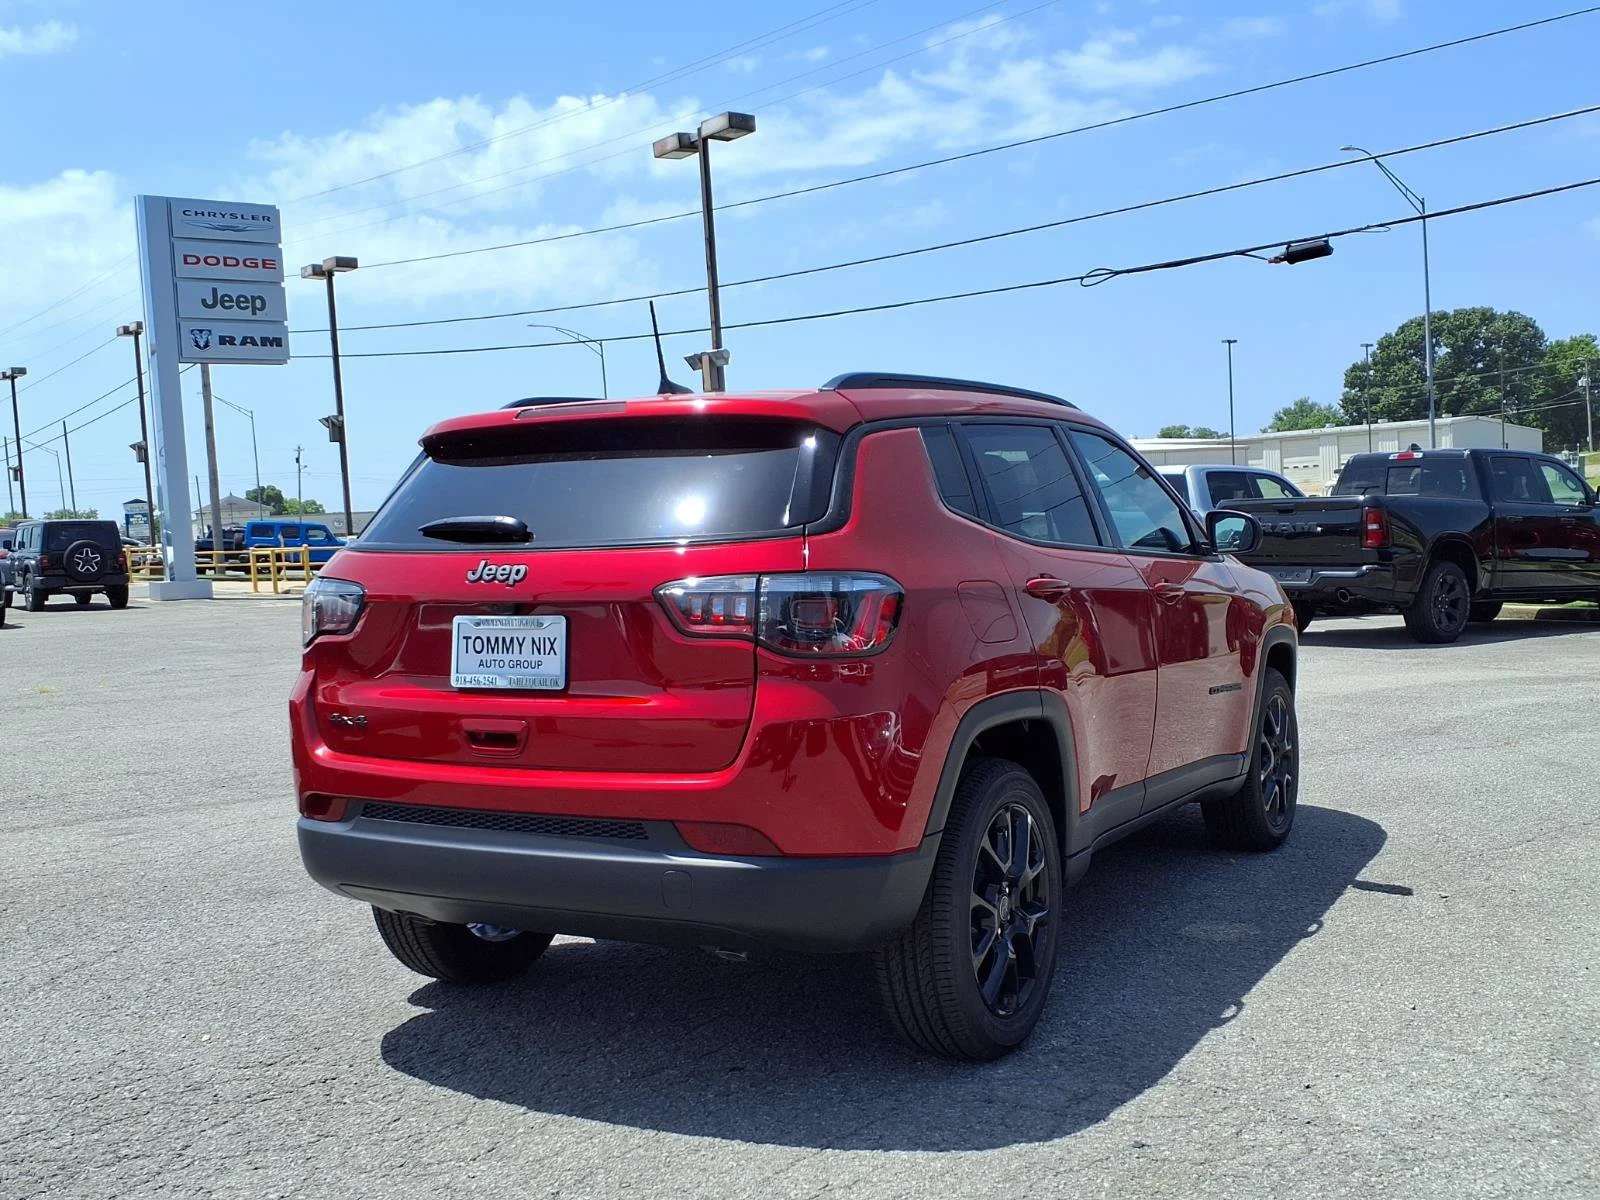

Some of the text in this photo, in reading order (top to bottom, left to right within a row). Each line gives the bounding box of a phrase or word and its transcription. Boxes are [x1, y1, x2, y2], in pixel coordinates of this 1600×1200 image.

[182, 209, 272, 222] CHRYSLER
[182, 254, 277, 270] DODGE
[200, 287, 267, 315] Jeep
[218, 335, 283, 347] RAM
[466, 559, 528, 586] Jeep
[462, 635, 558, 656] TOMMY NIX
[478, 659, 543, 669] AUTO GROUP
